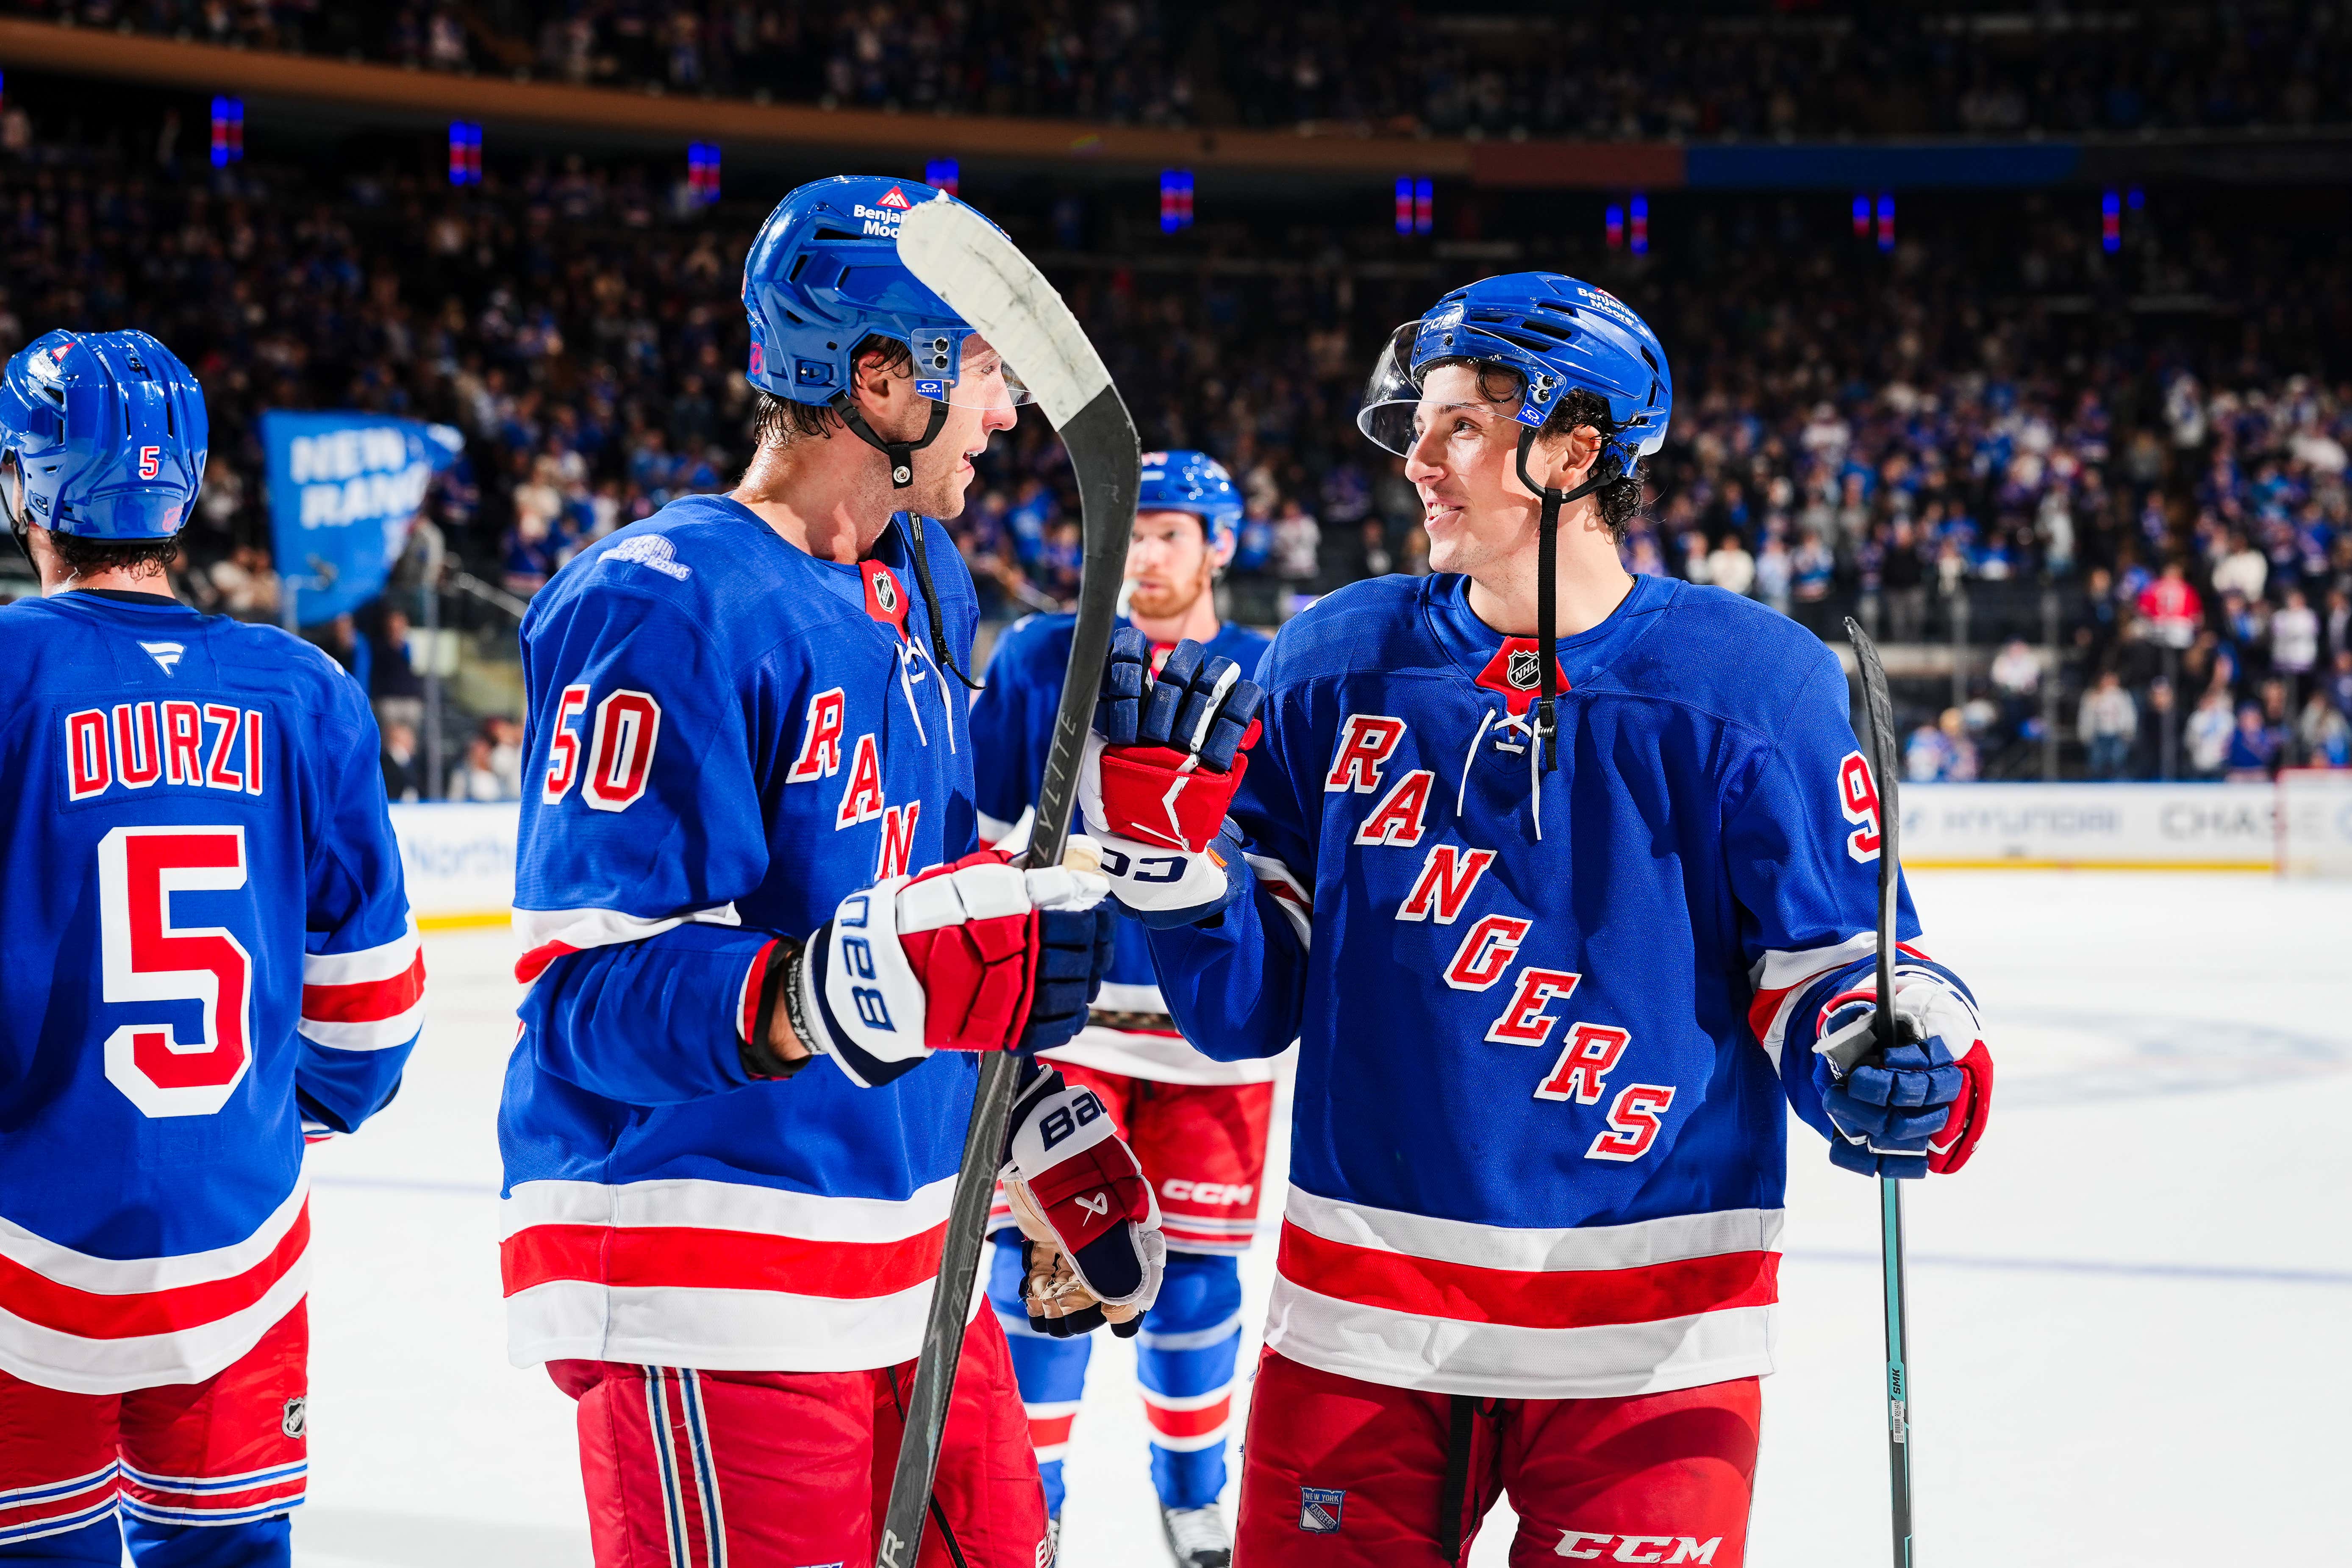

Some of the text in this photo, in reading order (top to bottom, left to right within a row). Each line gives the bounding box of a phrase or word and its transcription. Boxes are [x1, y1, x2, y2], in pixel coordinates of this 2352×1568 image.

[854, 204, 901, 225] Benja
[863, 220, 900, 239] Moo
[1577, 287, 1640, 322] Benjamin
[138, 446, 160, 480] 5
[290, 428, 407, 484] NEW
[1515, 661, 1537, 681] NHL
[65, 700, 263, 801] DURZI
[542, 684, 661, 813] 50
[786, 686, 944, 883] RAN
[1033, 710, 1078, 862] LYLITE
[1324, 714, 1676, 1162] RANGERS
[97, 825, 252, 1118] 5
[1161, 1178, 1254, 1206] CCM
[1892, 1368, 1901, 1395] SMK
[1322, 1494, 1339, 1502] YORK
[1309, 1504, 1335, 1529] RANGERS
[1553, 1529, 1723, 1567] CCM
